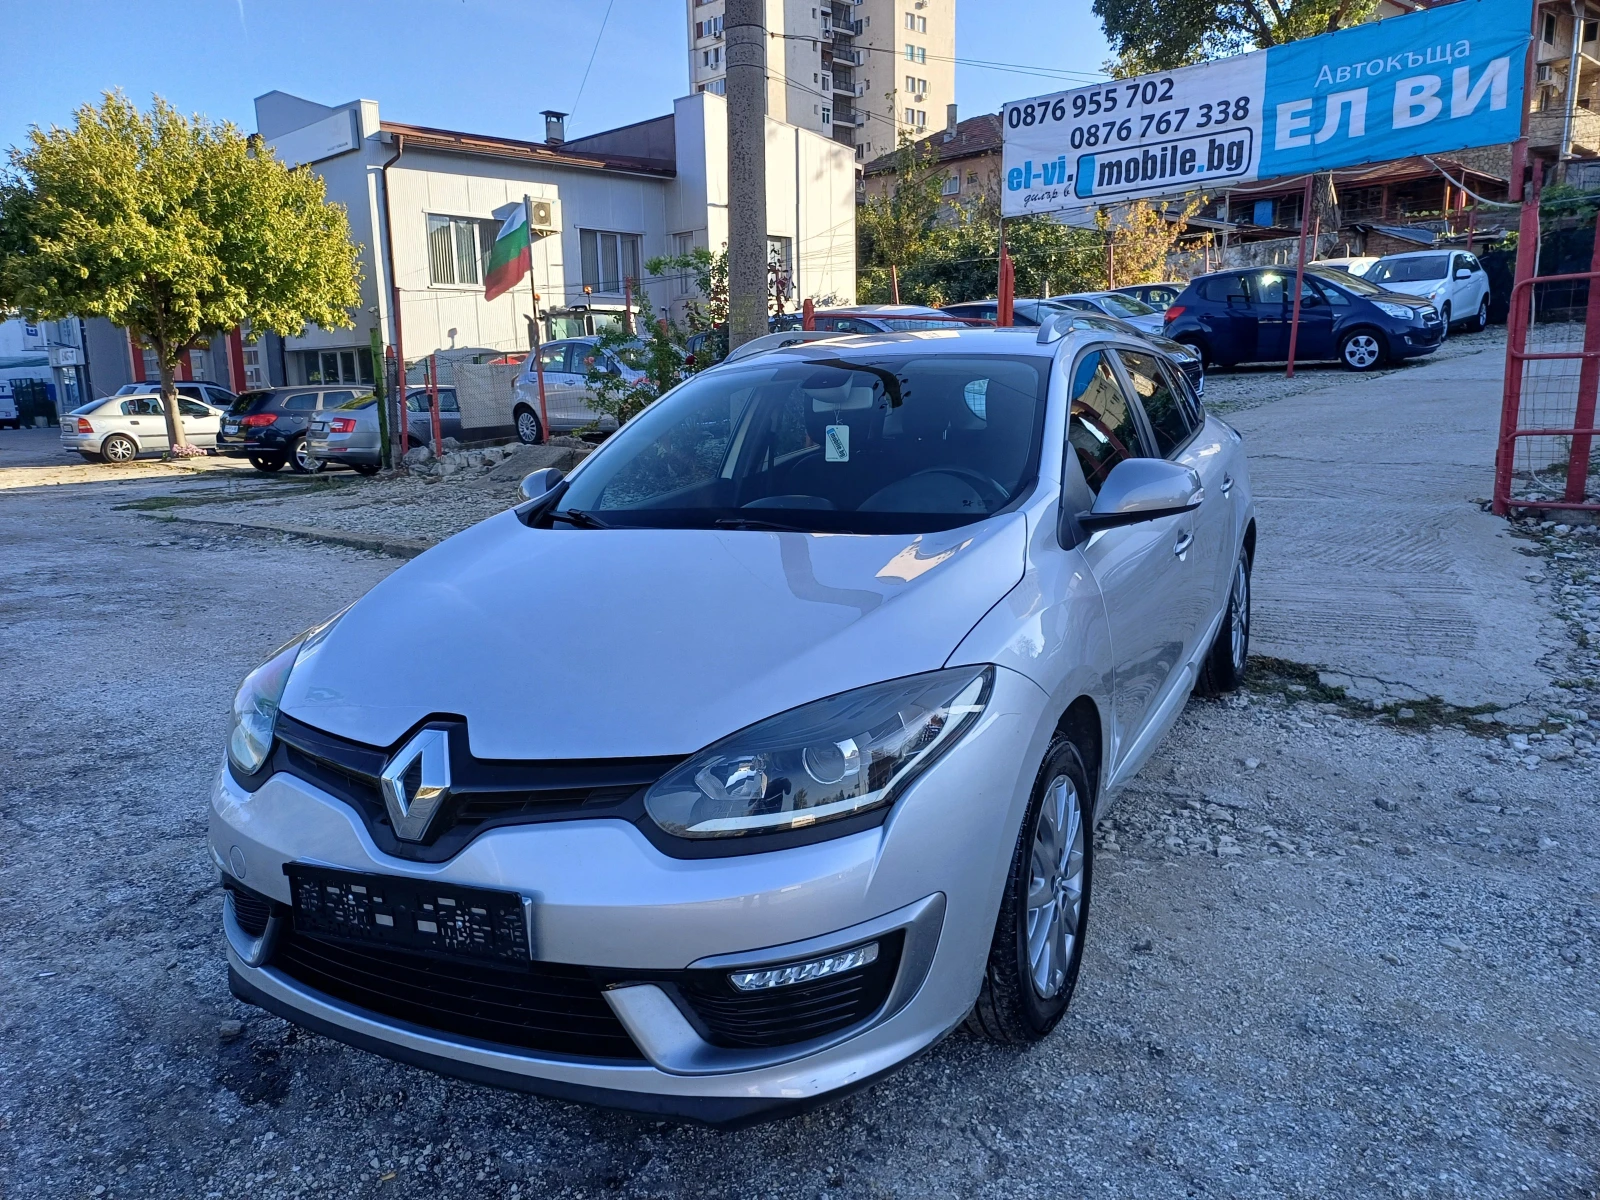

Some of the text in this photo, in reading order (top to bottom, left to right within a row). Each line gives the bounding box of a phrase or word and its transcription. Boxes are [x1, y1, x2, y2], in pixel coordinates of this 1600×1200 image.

[1314, 39, 1471, 88] Автокъща
[1008, 78, 1174, 129] 0876 955 702
[1070, 96, 1250, 149] 0876 767 338
[1274, 56, 1510, 151] ЕЛ ВИ
[1097, 138, 1245, 188] mobile.bg
